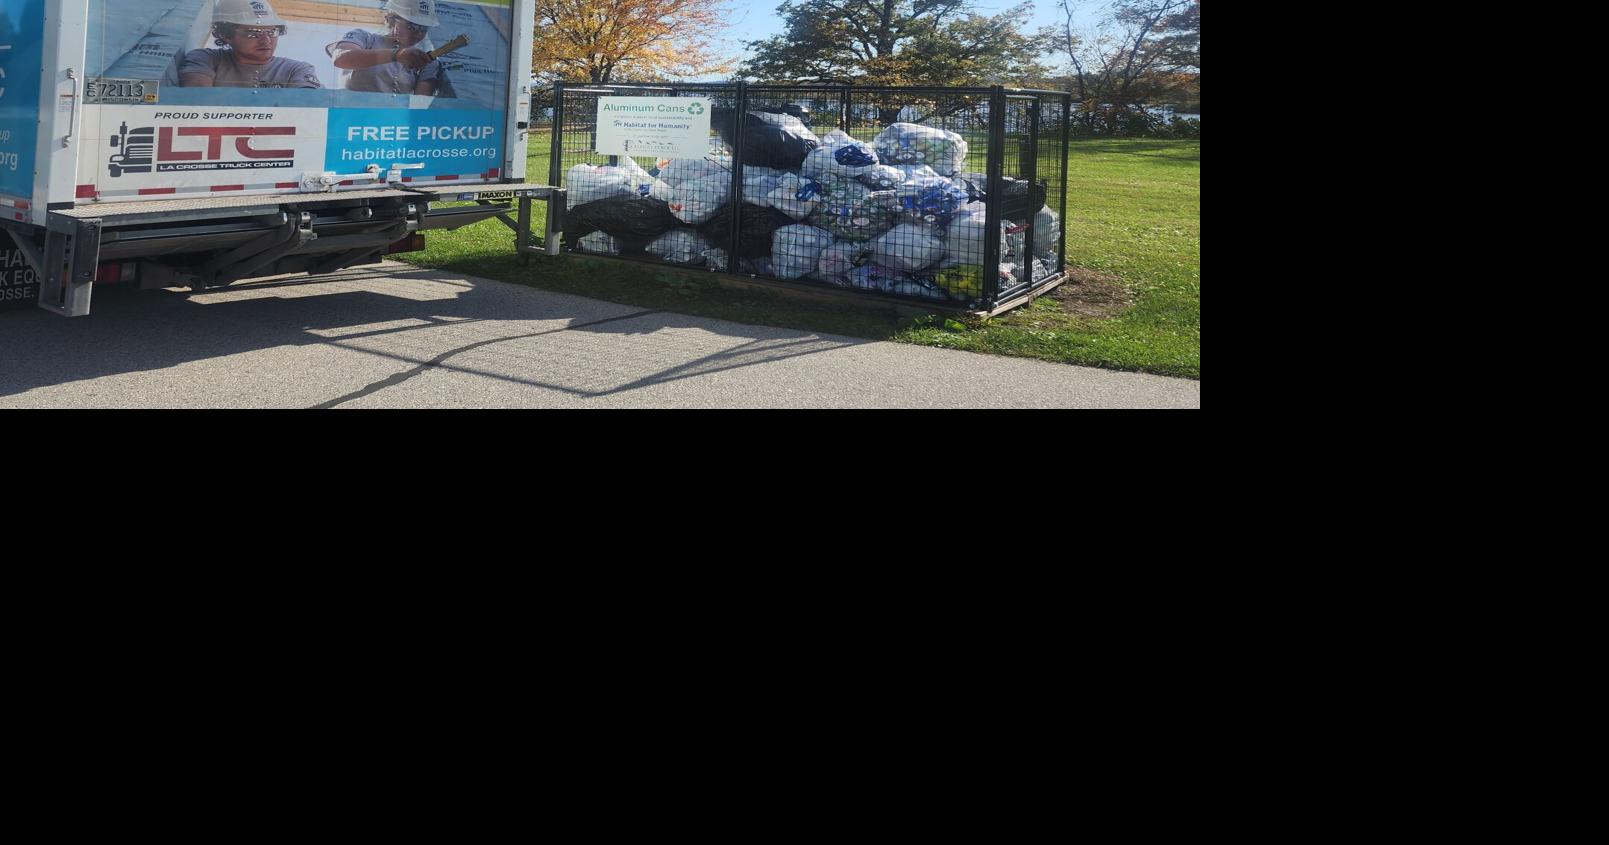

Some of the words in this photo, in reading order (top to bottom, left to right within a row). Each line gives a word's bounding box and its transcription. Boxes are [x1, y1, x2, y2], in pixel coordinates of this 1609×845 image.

[100, 83, 144, 97] 72113
[603, 103, 654, 112] Aluminum
[657, 103, 686, 113] Cans
[154, 112, 199, 120] PROUD
[202, 112, 273, 120] SUPPORTER
[347, 126, 410, 141] FREE
[417, 126, 494, 140] PICKUP
[157, 126, 296, 161] LTC
[341, 147, 496, 161] habitatlacrosse.org
